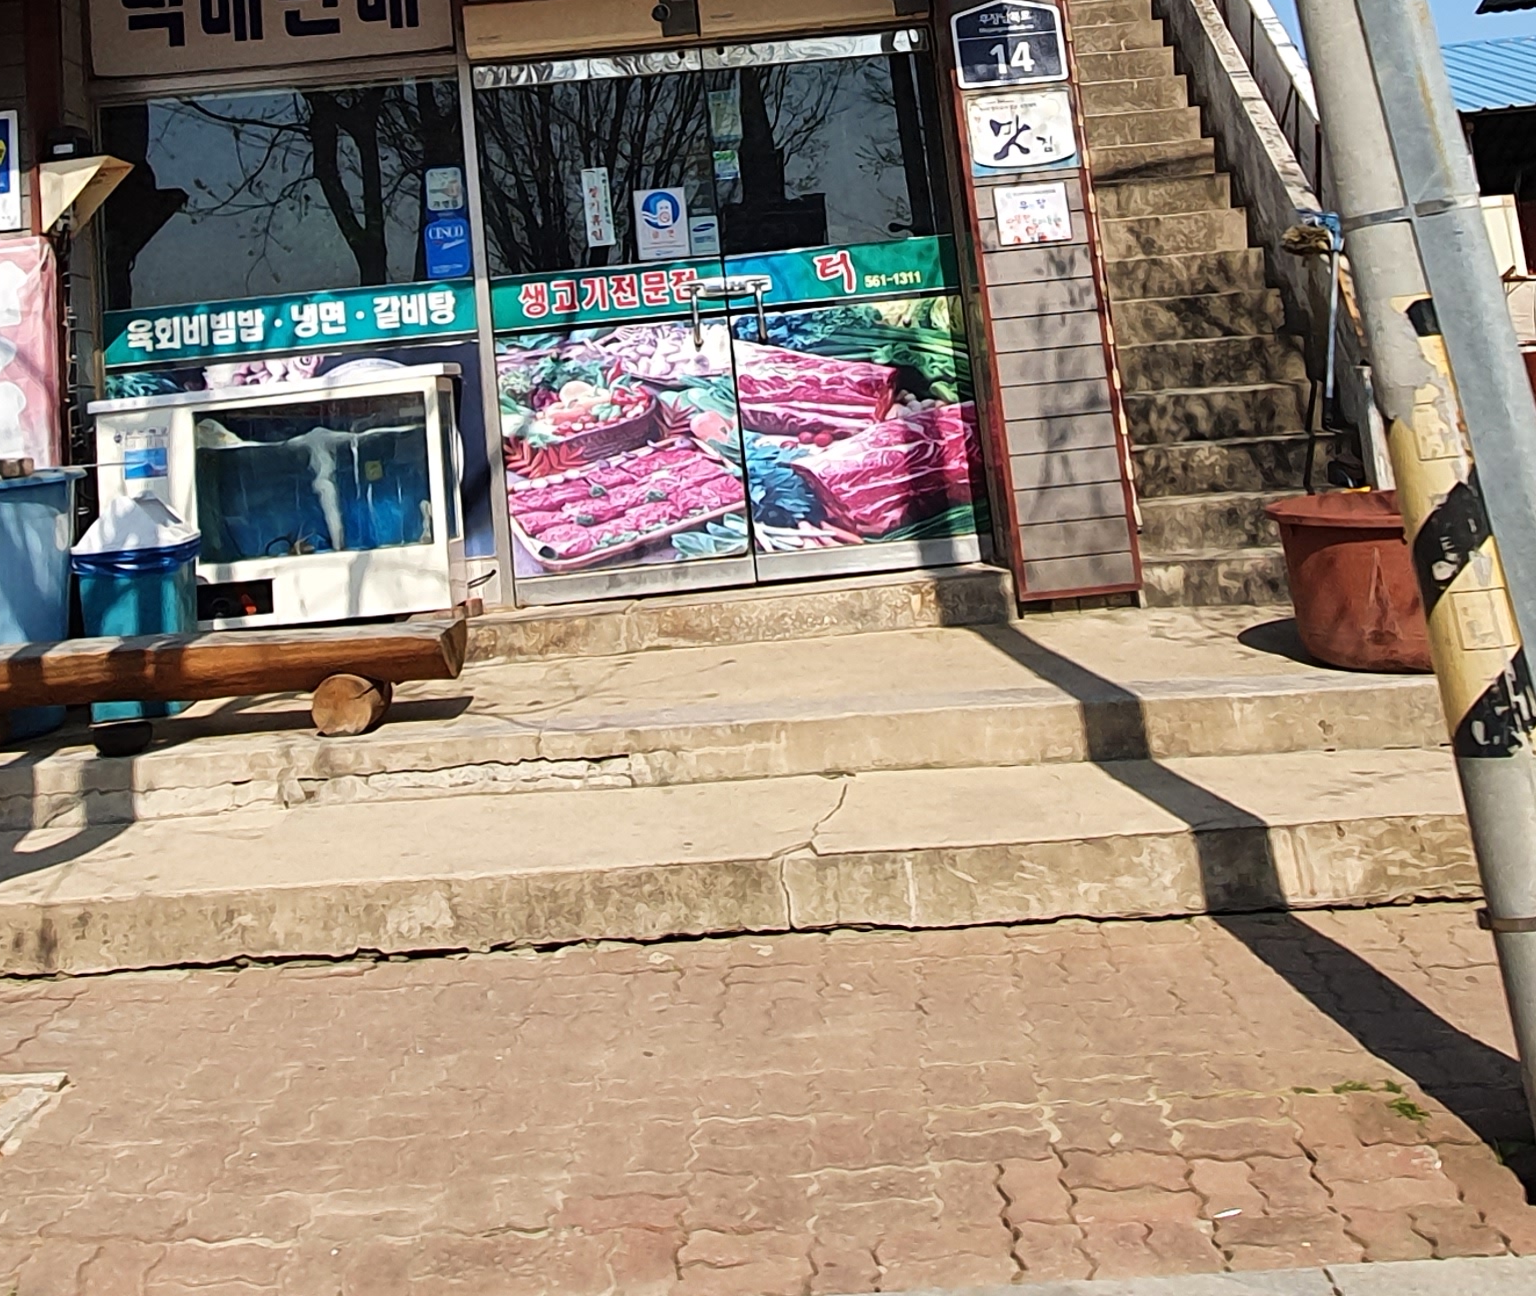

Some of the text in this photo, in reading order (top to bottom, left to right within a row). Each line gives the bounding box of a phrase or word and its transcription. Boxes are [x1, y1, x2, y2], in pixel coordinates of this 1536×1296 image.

[989, 41, 1036, 74] 14
[518, 266, 700, 320] 생고기전문점
[812, 249, 923, 294] 터 561-1311
[126, 289, 457, 352] 육회비빔밥 냉면 갈비탕
